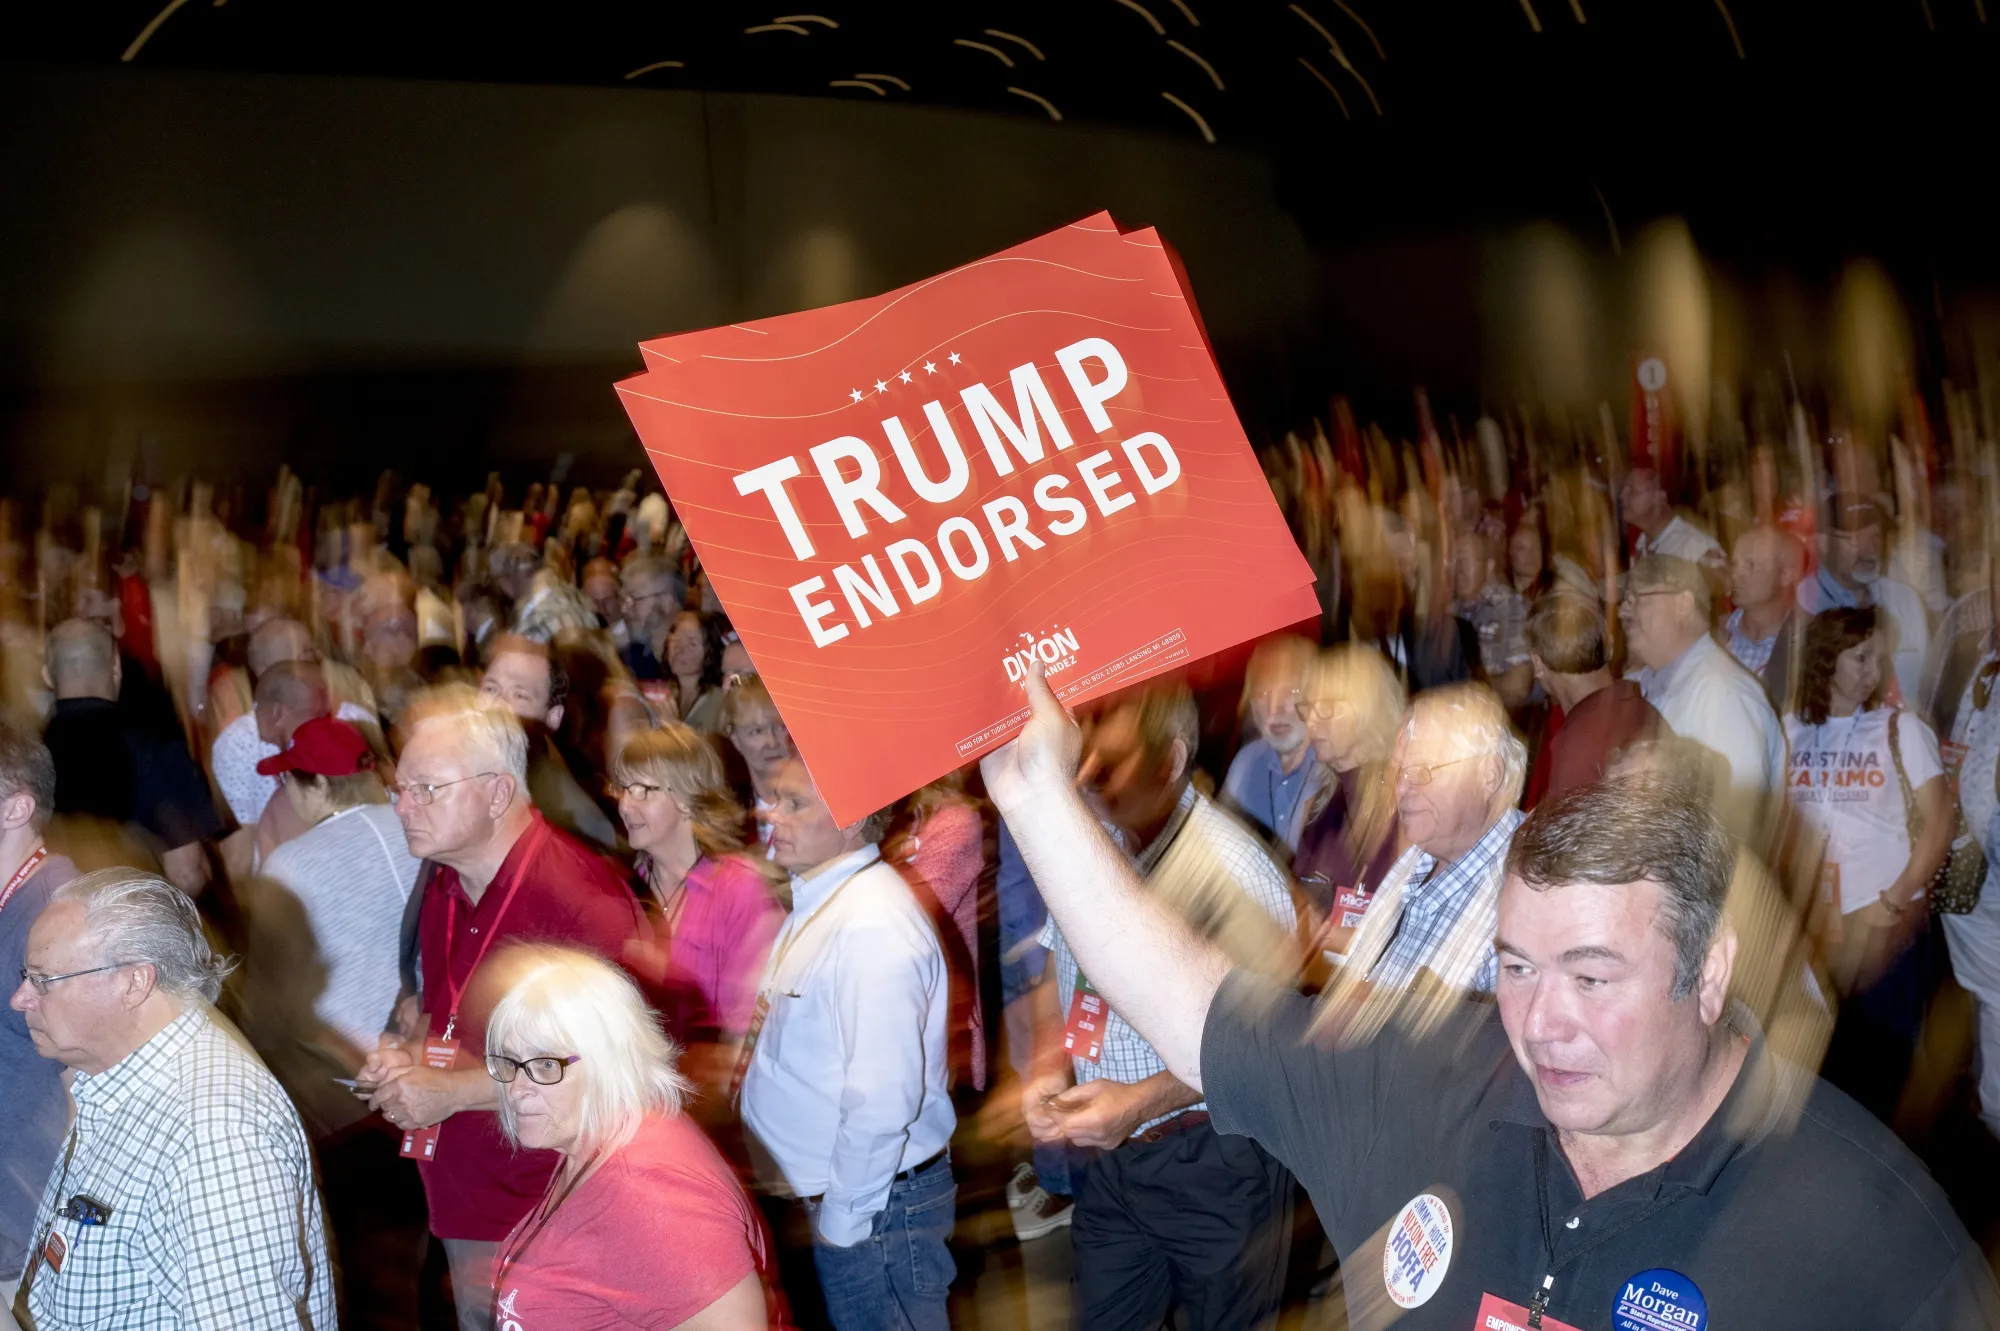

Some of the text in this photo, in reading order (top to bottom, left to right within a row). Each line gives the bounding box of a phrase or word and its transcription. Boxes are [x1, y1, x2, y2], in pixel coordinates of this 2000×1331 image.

[732, 337, 1129, 562] TRUMP
[788, 431, 1182, 648] ENDORSED
[1002, 627, 1081, 683] DIXON
[1019, 655, 1078, 690] HANDEZ
[959, 741, 973, 751] PAID
[973, 735, 984, 745] FOR
[983, 731, 991, 740] BY
[990, 723, 1007, 736] TUDOR
[1006, 715, 1021, 727] DIXON
[1021, 709, 1032, 719] FOR
[1081, 678, 1091, 687] PO
[1091, 672, 1105, 683] BOX
[1125, 647, 1152, 665] LANSING
[1152, 643, 1161, 652] MI
[1790, 750, 1880, 768] KRSTINA
[1402, 1208, 1439, 1274] NIXON FREE
[1414, 1197, 1447, 1256] JIMMY HOFFA
[1392, 1225, 1426, 1293] HOFFA
[1622, 1283, 1700, 1327] Morgan
[1630, 1307, 1646, 1319] State
[1651, 1281, 1679, 1300] Dave
[1621, 1320, 1632, 1329] All
